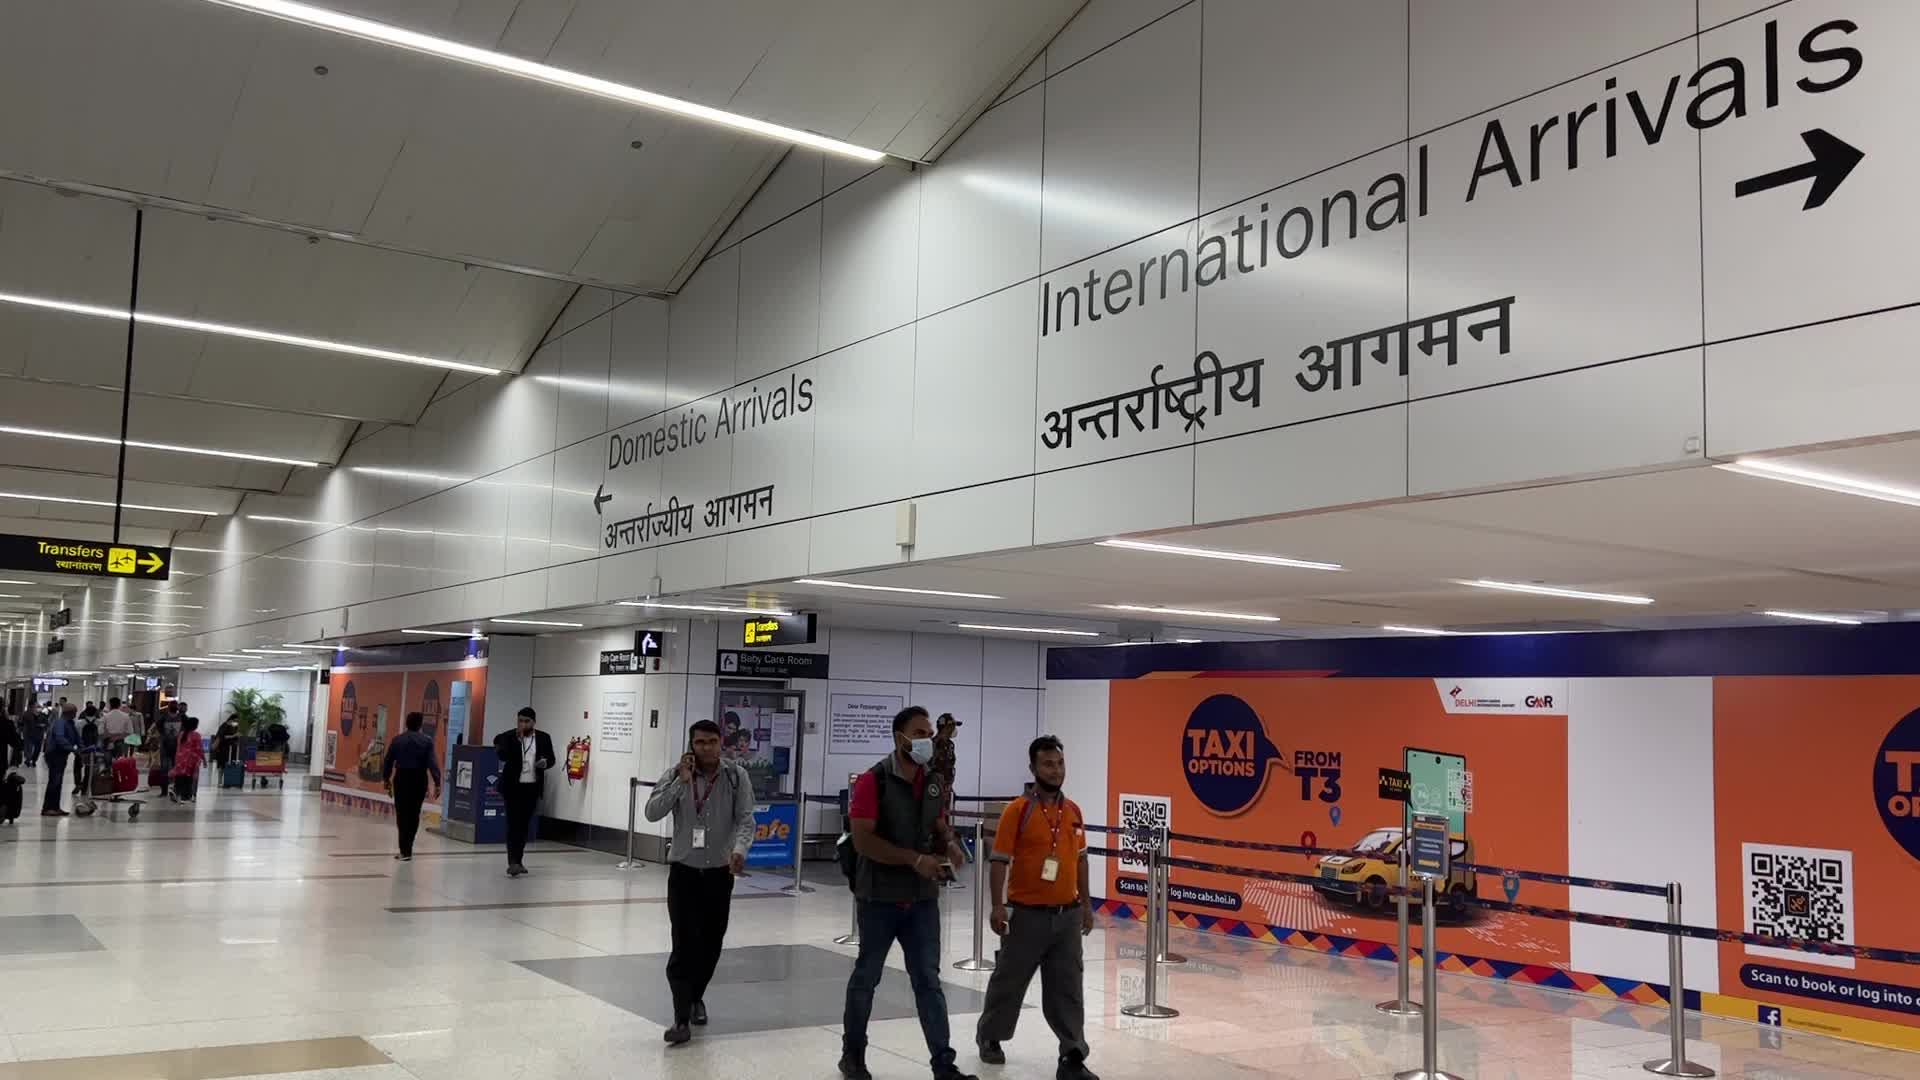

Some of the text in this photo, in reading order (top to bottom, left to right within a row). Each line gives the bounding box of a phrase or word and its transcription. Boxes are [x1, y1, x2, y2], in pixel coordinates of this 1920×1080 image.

[1041, 17, 1863, 336] International Arrivals
[1041, 296, 1515, 450] अन्तर्राष्ट्रीय आगमन
[609, 374, 813, 470] Domestic Arrivals
[605, 485, 775, 548] अन्तर्राज्यीय आगमन
[37, 541, 104, 558] Transfers
[740, 653, 812, 665] Baby Care Room
[1455, 699, 1477, 707] DELHI
[1187, 729, 1255, 759] TAXI
[1188, 759, 1255, 777] OPTIONS
[1294, 751, 1341, 767] FROM
[1294, 767, 1341, 803] T3
[1388, 777, 1403, 788] TAXI
[755, 818, 791, 841] afe
[1119, 879, 1136, 890] Scan
[1136, 883, 1144, 892] to
[1170, 886, 1182, 900] log
[1182, 889, 1197, 900] into
[1751, 968, 1782, 985] Scan
[1784, 975, 1799, 988] to
[1801, 976, 1837, 994] book
[1839, 985, 1855, 996] or
[1857, 985, 1880, 1003] log
[1883, 989, 1912, 1006] into
